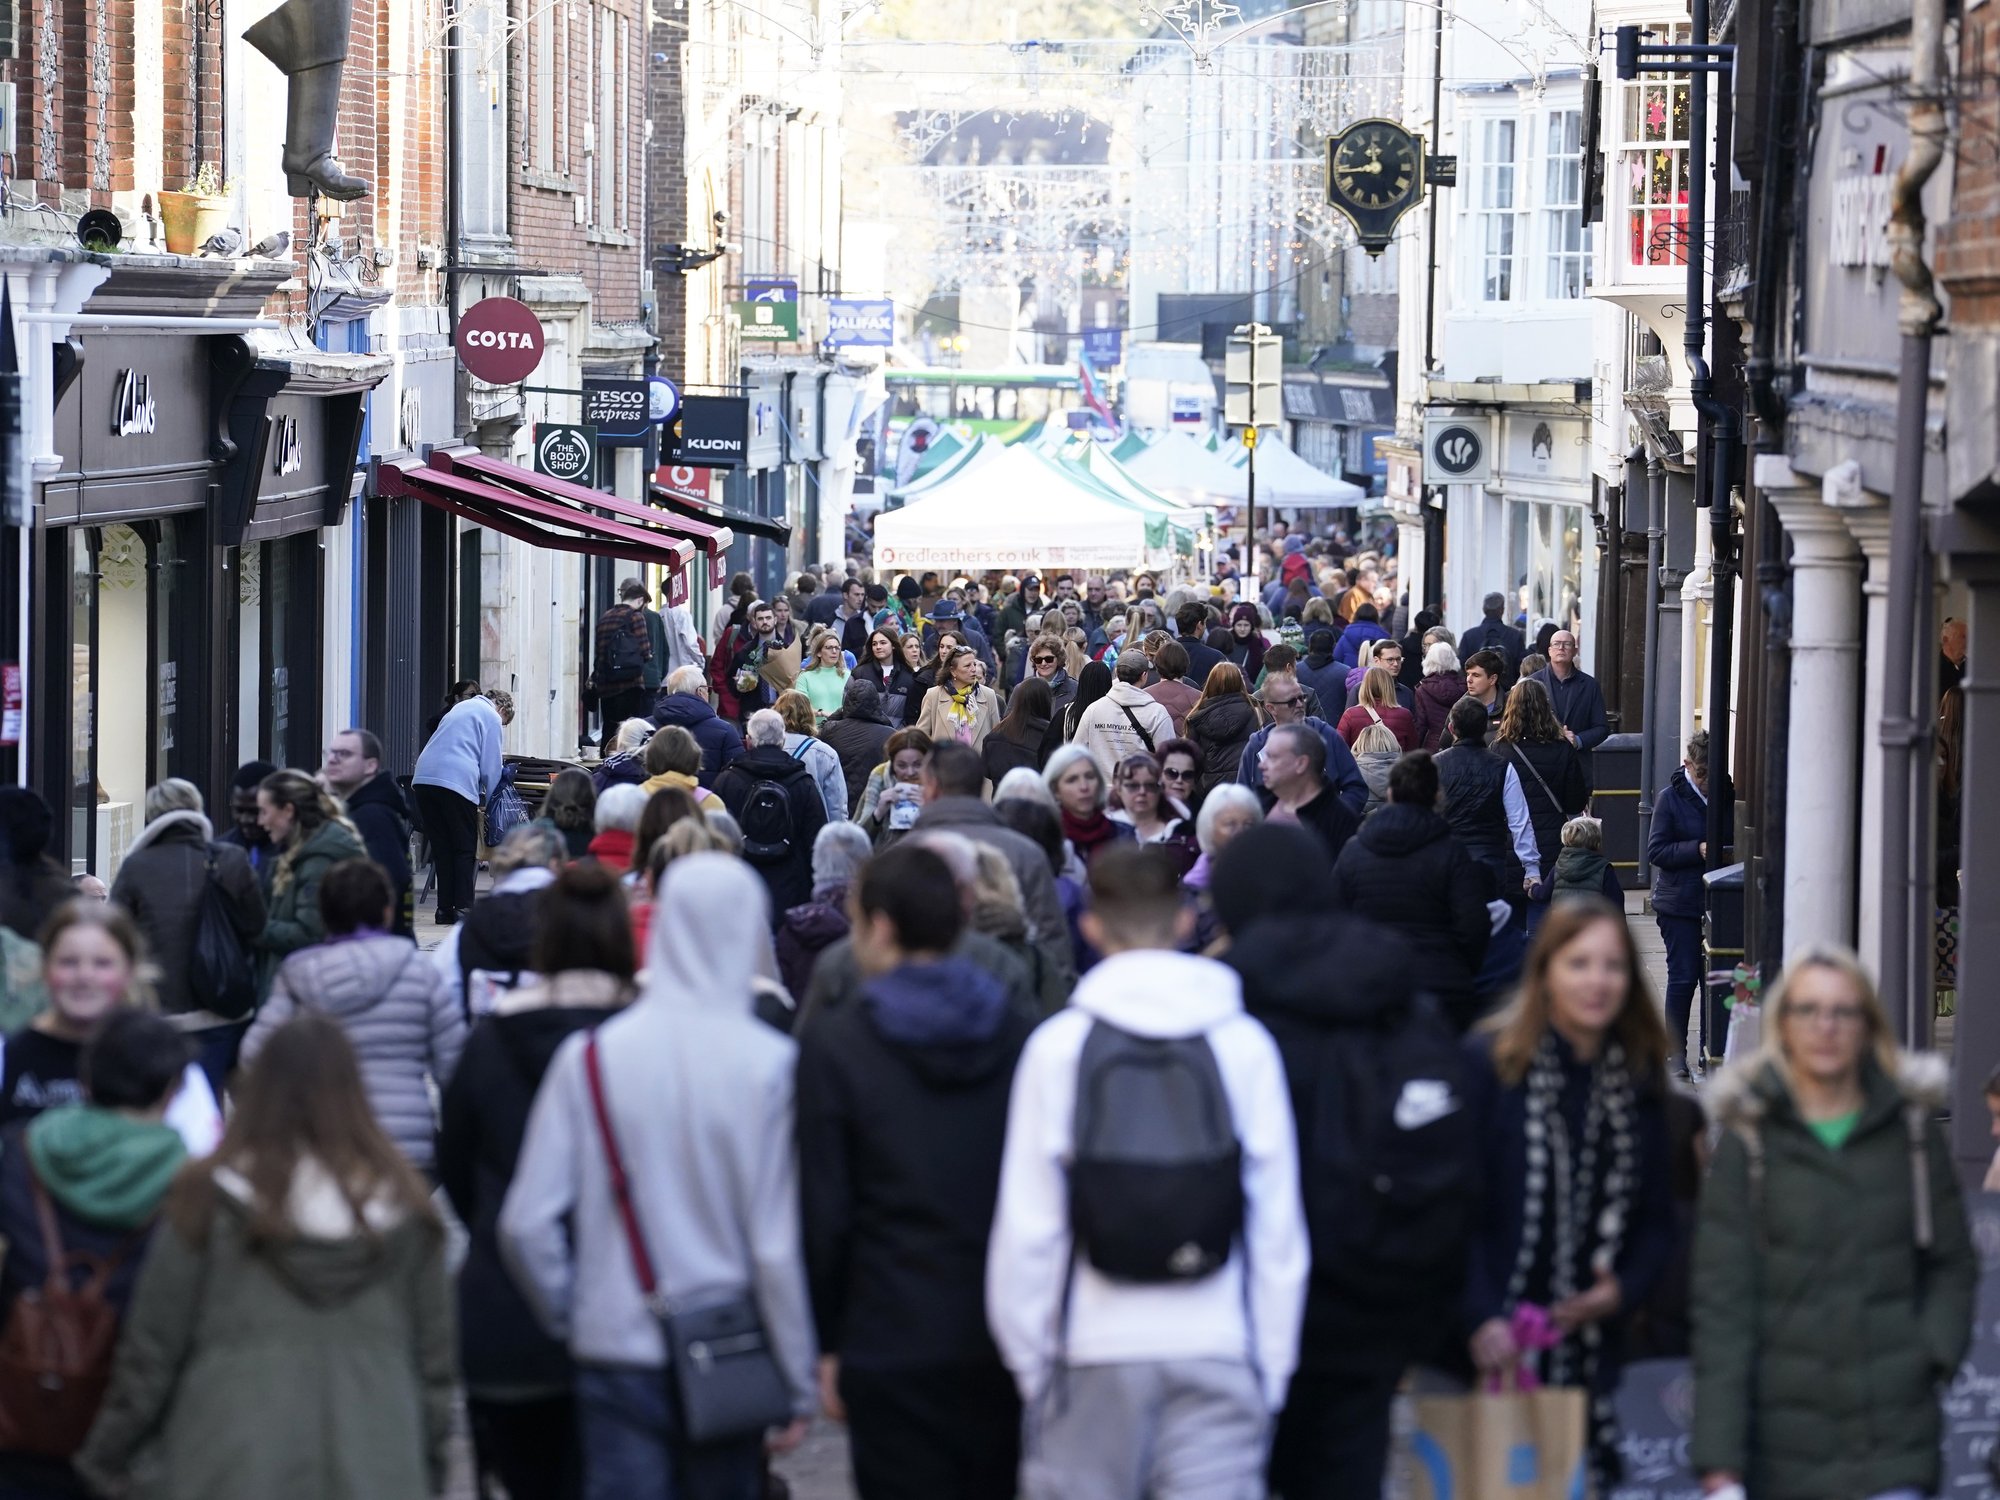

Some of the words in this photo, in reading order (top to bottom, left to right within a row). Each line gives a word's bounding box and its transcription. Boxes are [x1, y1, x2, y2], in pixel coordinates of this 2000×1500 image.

[829, 316, 891, 330] HALIFAX
[466, 329, 534, 350] COSTA
[120, 368, 155, 437] Clarks
[590, 408, 641, 423] express
[556, 444, 574, 453] THE
[687, 439, 741, 451] KUONI
[550, 451, 581, 462] BODY
[551, 461, 579, 471] SHOP
[898, 548, 1040, 562] redleathers.co.uk
[1106, 723, 1128, 731] MIYUKI
